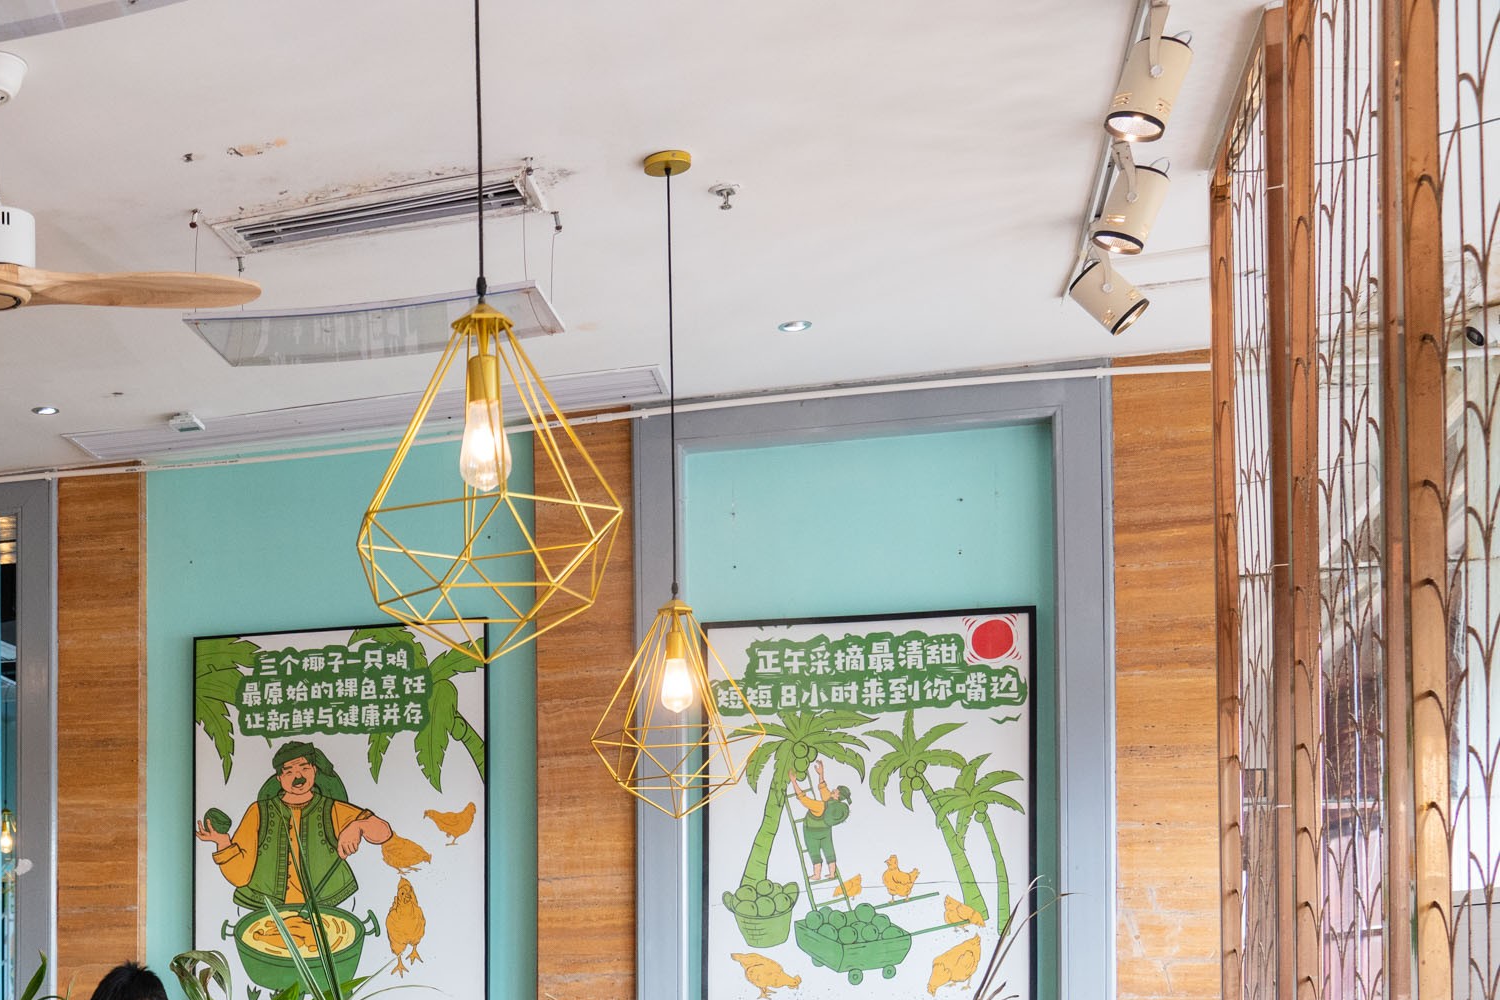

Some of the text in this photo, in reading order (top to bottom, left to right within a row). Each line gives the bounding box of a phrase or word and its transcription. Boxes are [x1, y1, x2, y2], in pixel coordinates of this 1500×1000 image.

[259, 649, 408, 676] 三个椰子一只鸡
[755, 640, 958, 674] 正午采摘最清甜
[242, 675, 426, 707] 最原始的裸色烹饪
[717, 672, 1020, 709] 短短8小时来到你嘴边
[244, 702, 423, 731] 让新鲜与健康并存
